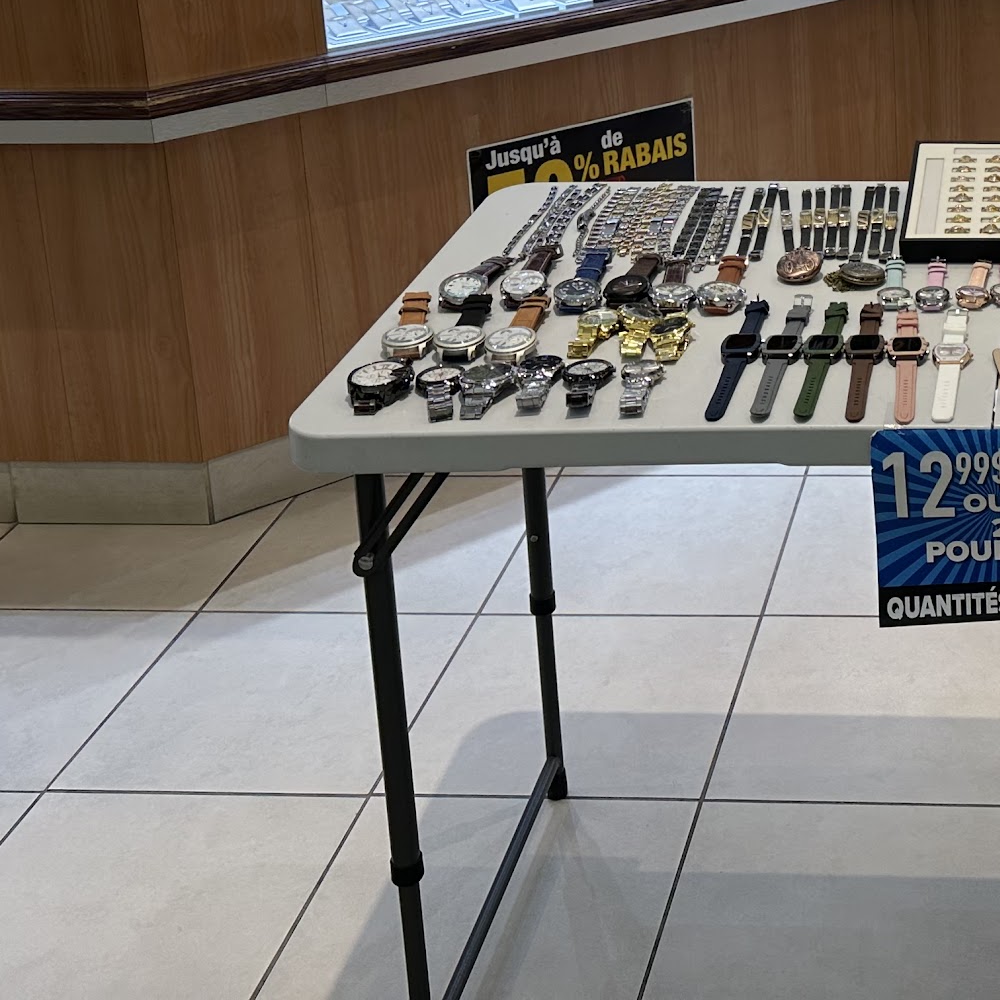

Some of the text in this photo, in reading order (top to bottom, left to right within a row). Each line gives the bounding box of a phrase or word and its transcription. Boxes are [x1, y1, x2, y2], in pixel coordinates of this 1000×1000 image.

[485, 130, 624, 170] Jusqu'à de
[603, 132, 688, 175] RABAIS
